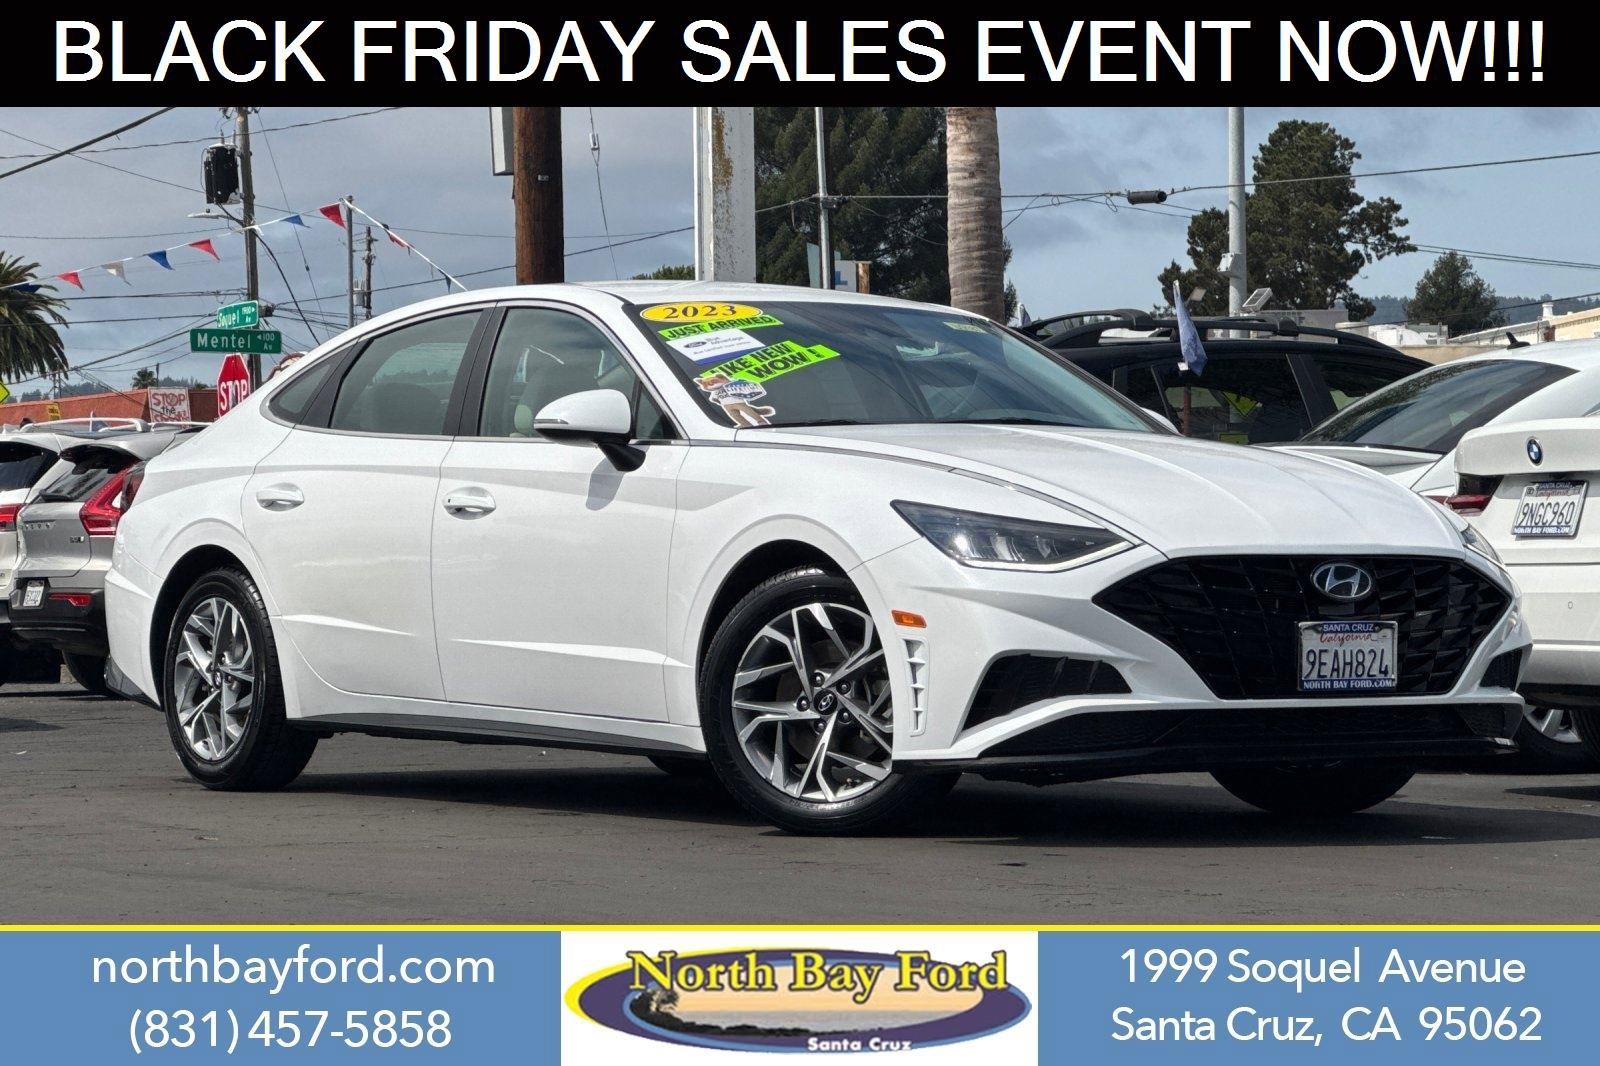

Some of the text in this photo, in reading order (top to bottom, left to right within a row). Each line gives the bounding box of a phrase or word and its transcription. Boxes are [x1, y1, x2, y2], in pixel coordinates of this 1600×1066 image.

[664, 304, 737, 319] 2023
[263, 333, 275, 341] 100
[668, 325, 707, 339] JUST
[197, 333, 251, 349] Mentel
[755, 343, 792, 361] NEW
[746, 352, 808, 379] WOW
[152, 393, 186, 406] STOP
[220, 380, 248, 411] STOP
[1518, 501, 1576, 526] 9NGC960
[1322, 624, 1374, 632] SANTA CRUZ
[1319, 632, 1377, 647] California
[1304, 648, 1389, 679] 9EAH824
[1303, 681, 1331, 689] NORTH
[1333, 681, 1348, 689] BAY
